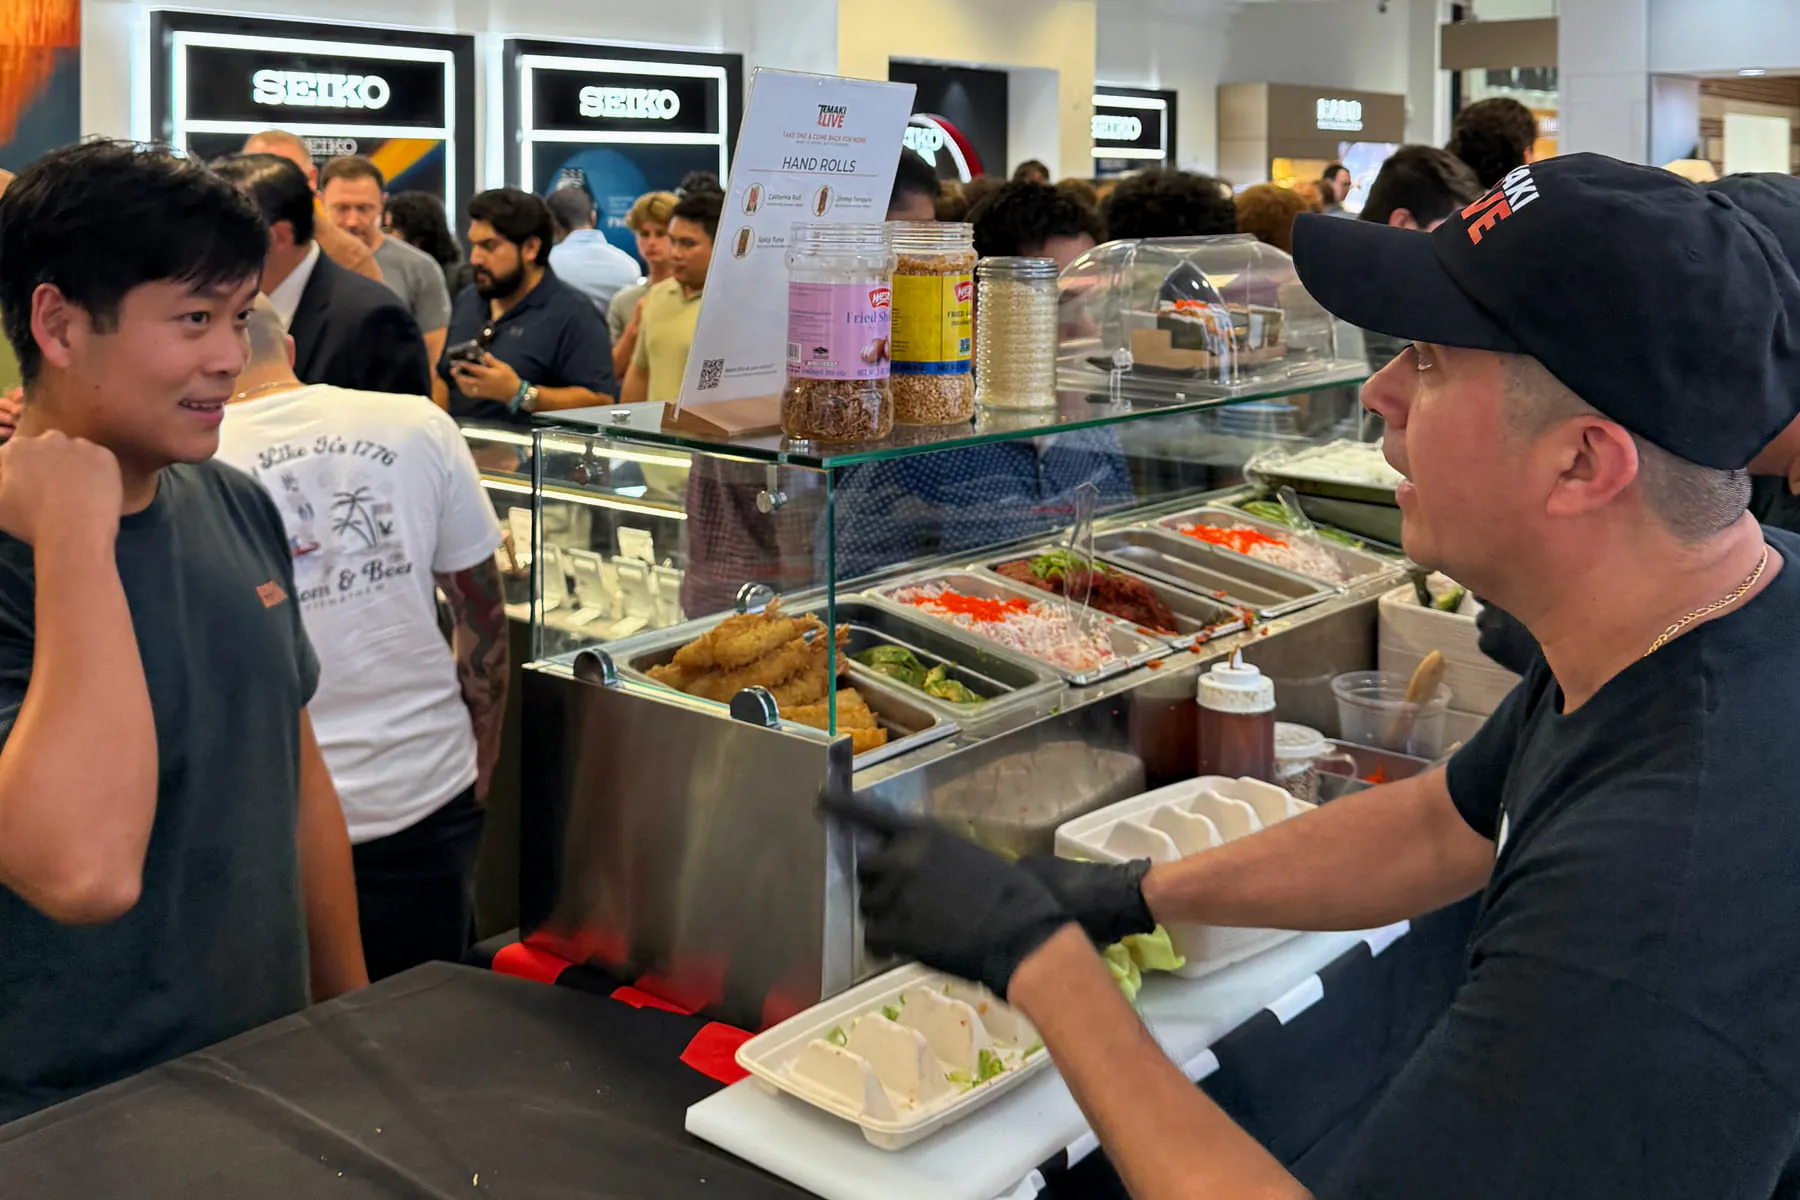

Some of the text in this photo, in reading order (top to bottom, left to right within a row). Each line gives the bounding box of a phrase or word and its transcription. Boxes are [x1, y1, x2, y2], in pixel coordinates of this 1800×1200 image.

[252, 69, 391, 110] SEIKO
[578, 85, 681, 120] SEIKO
[818, 104, 847, 116] TEMAKI
[1091, 115, 1142, 141] EIKO
[781, 156, 857, 173] HAND ROLLS
[1502, 165, 1540, 213] AKI
[846, 311, 877, 324] Fried
[257, 435, 398, 469] Like It's 1776
[338, 568, 357, 591] &
[361, 557, 413, 582] Beer
